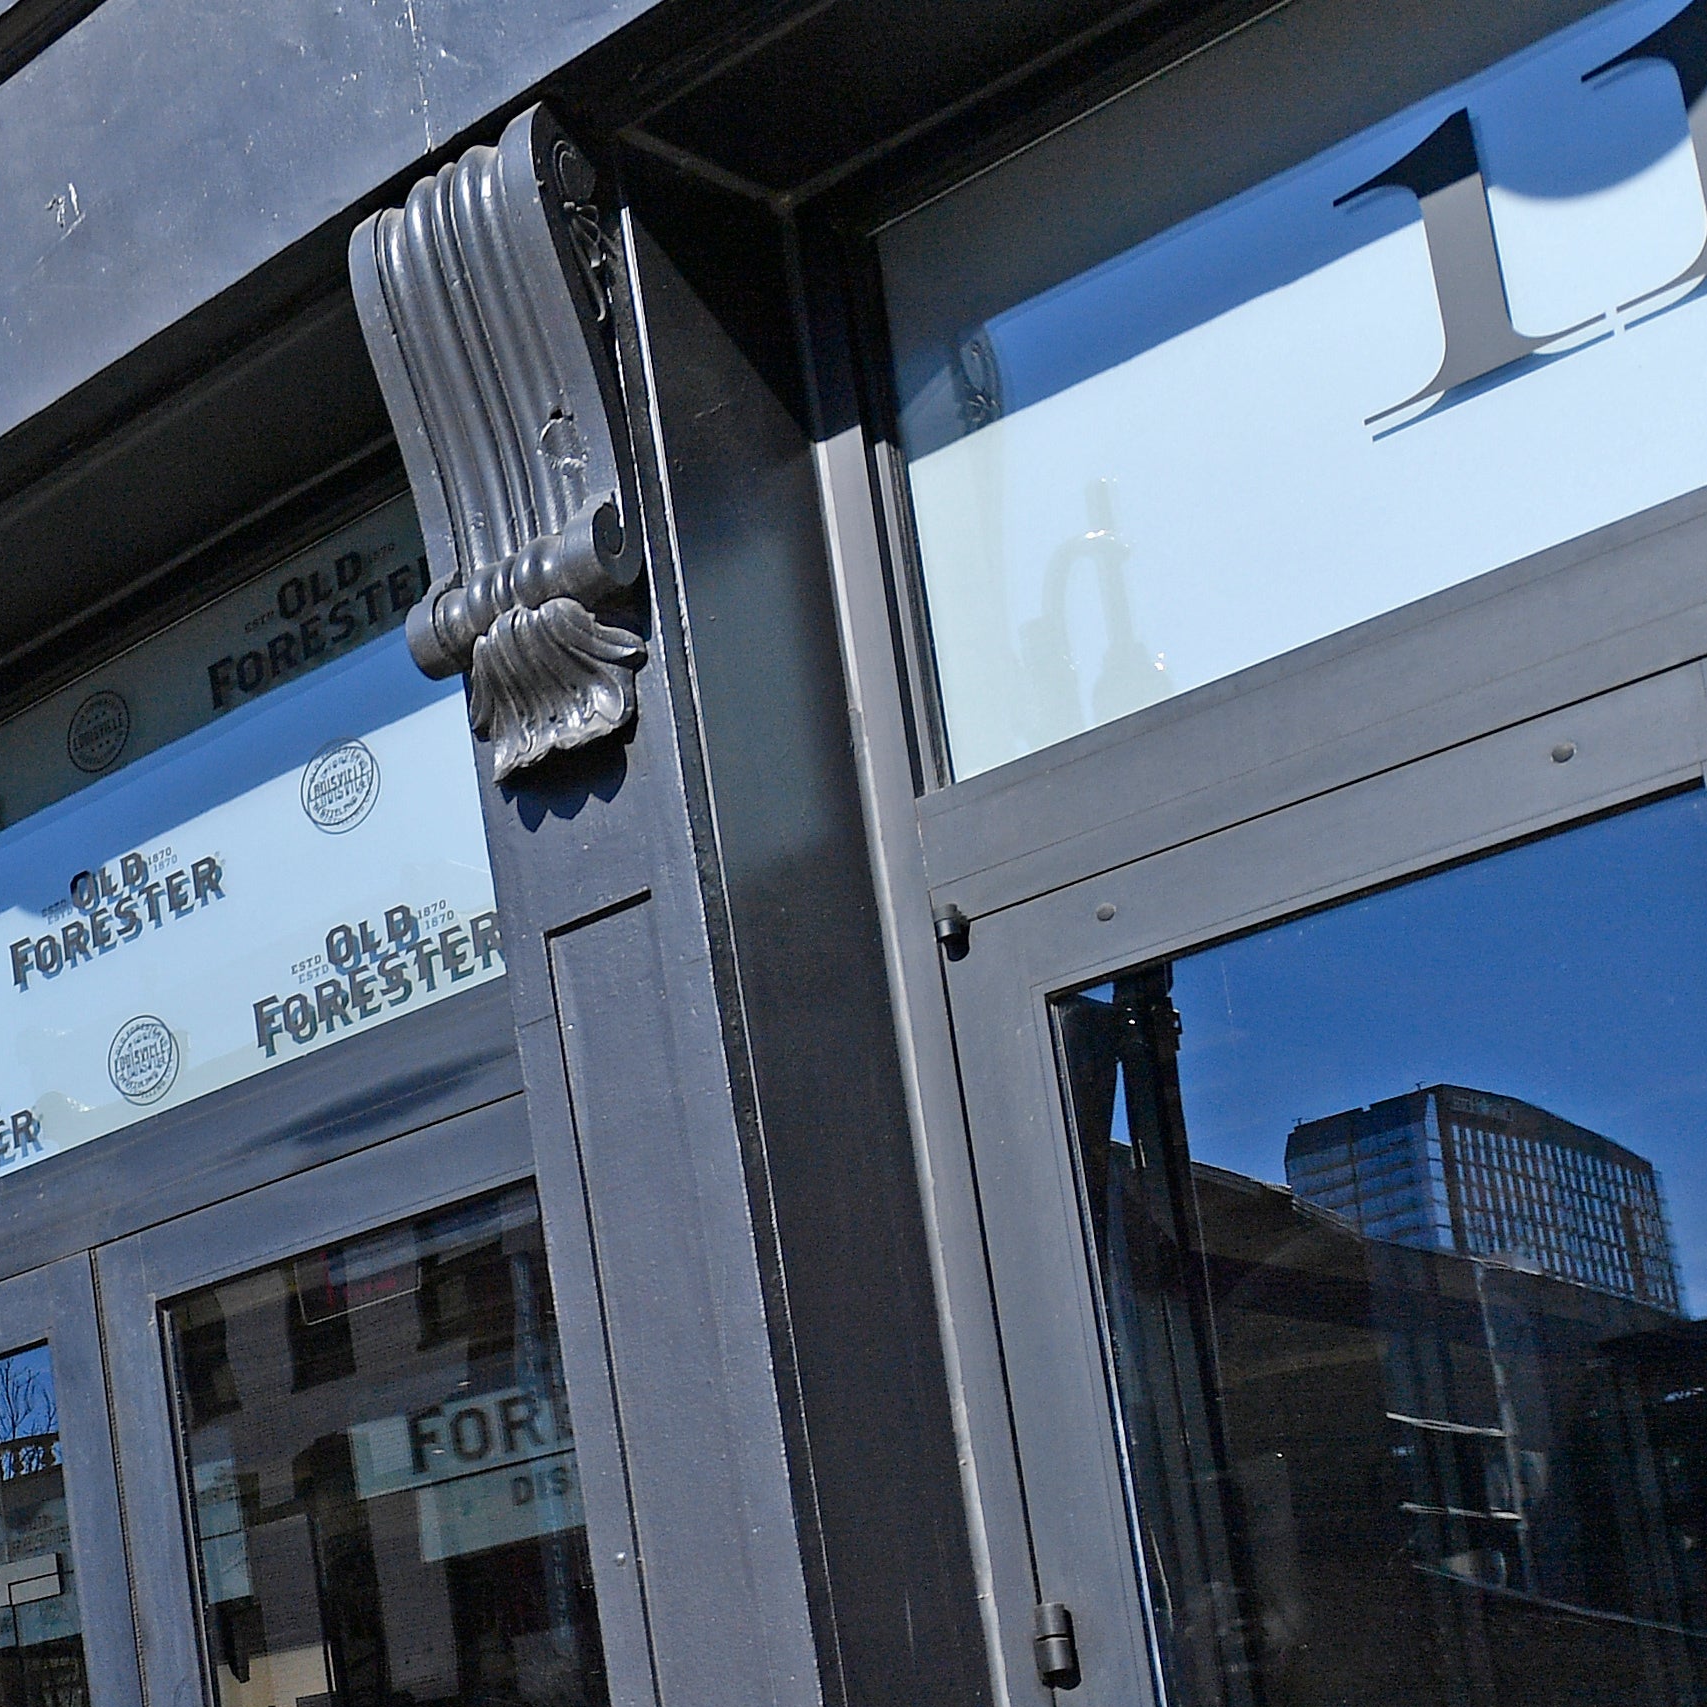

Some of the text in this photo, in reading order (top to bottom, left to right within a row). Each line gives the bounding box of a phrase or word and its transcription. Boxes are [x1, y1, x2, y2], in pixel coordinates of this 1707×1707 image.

[277, 551, 362, 620] OLD
[207, 557, 431, 710] FORESTE
[70, 851, 148, 914] OLD
[417, 899, 447, 920] 1870
[9, 855, 224, 988] FORESTER
[325, 903, 414, 970] OLD
[252, 911, 504, 1054] FORESTER
[291, 953, 321, 975] ESTD
